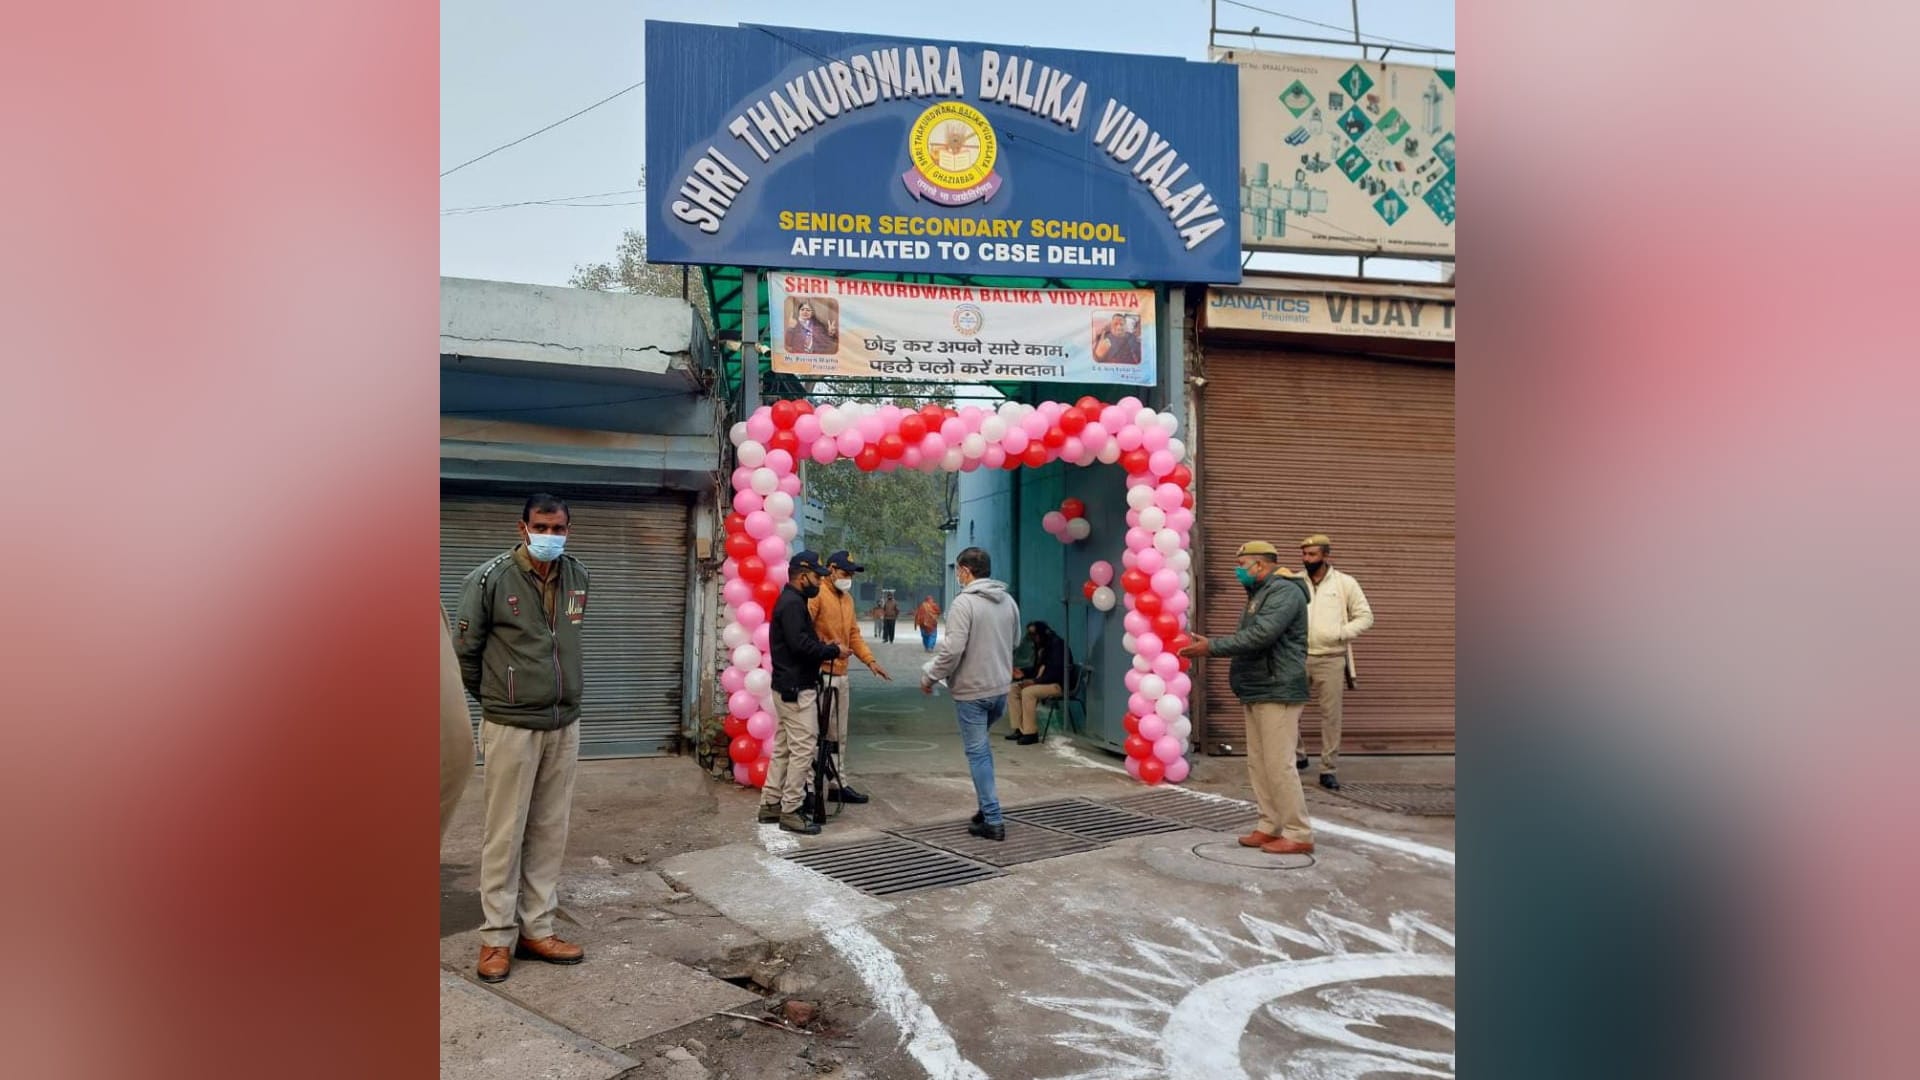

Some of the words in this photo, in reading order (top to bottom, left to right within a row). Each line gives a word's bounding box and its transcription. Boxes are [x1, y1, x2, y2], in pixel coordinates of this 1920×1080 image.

[671, 145, 750, 233] SHRI
[728, 45, 965, 163] THAKURDWARA
[979, 49, 1088, 131] BALIKA
[1093, 97, 1226, 251] VIDYALAYA
[914, 147, 927, 166] SHRI
[932, 170, 975, 184] GHAZIABAD
[778, 211, 872, 234] SENIOR
[878, 215, 1023, 238] SECONDARY
[1030, 219, 1126, 243] SCHOOL
[790, 237, 930, 260] AFFILIATED
[937, 241, 970, 261] TO
[978, 242, 1040, 263] CBSE
[1047, 245, 1116, 266] DELHI
[784, 276, 829, 294] SHRI
[835, 279, 974, 301] THAKURDWARA
[979, 288, 1042, 304] BALIKA
[1047, 290, 1139, 308] VIDYALAYA
[1211, 295, 1310, 313] JANATICS
[1325, 292, 1424, 327] VIJAY
[863, 335, 897, 355] छोड़
[902, 339, 934, 352] कर
[937, 338, 983, 354] अपने
[987, 340, 1020, 355] सारे
[1024, 344, 1069, 358] काम,
[870, 357, 914, 373] पहले
[918, 358, 955, 374] चलो
[960, 359, 992, 375] करें
